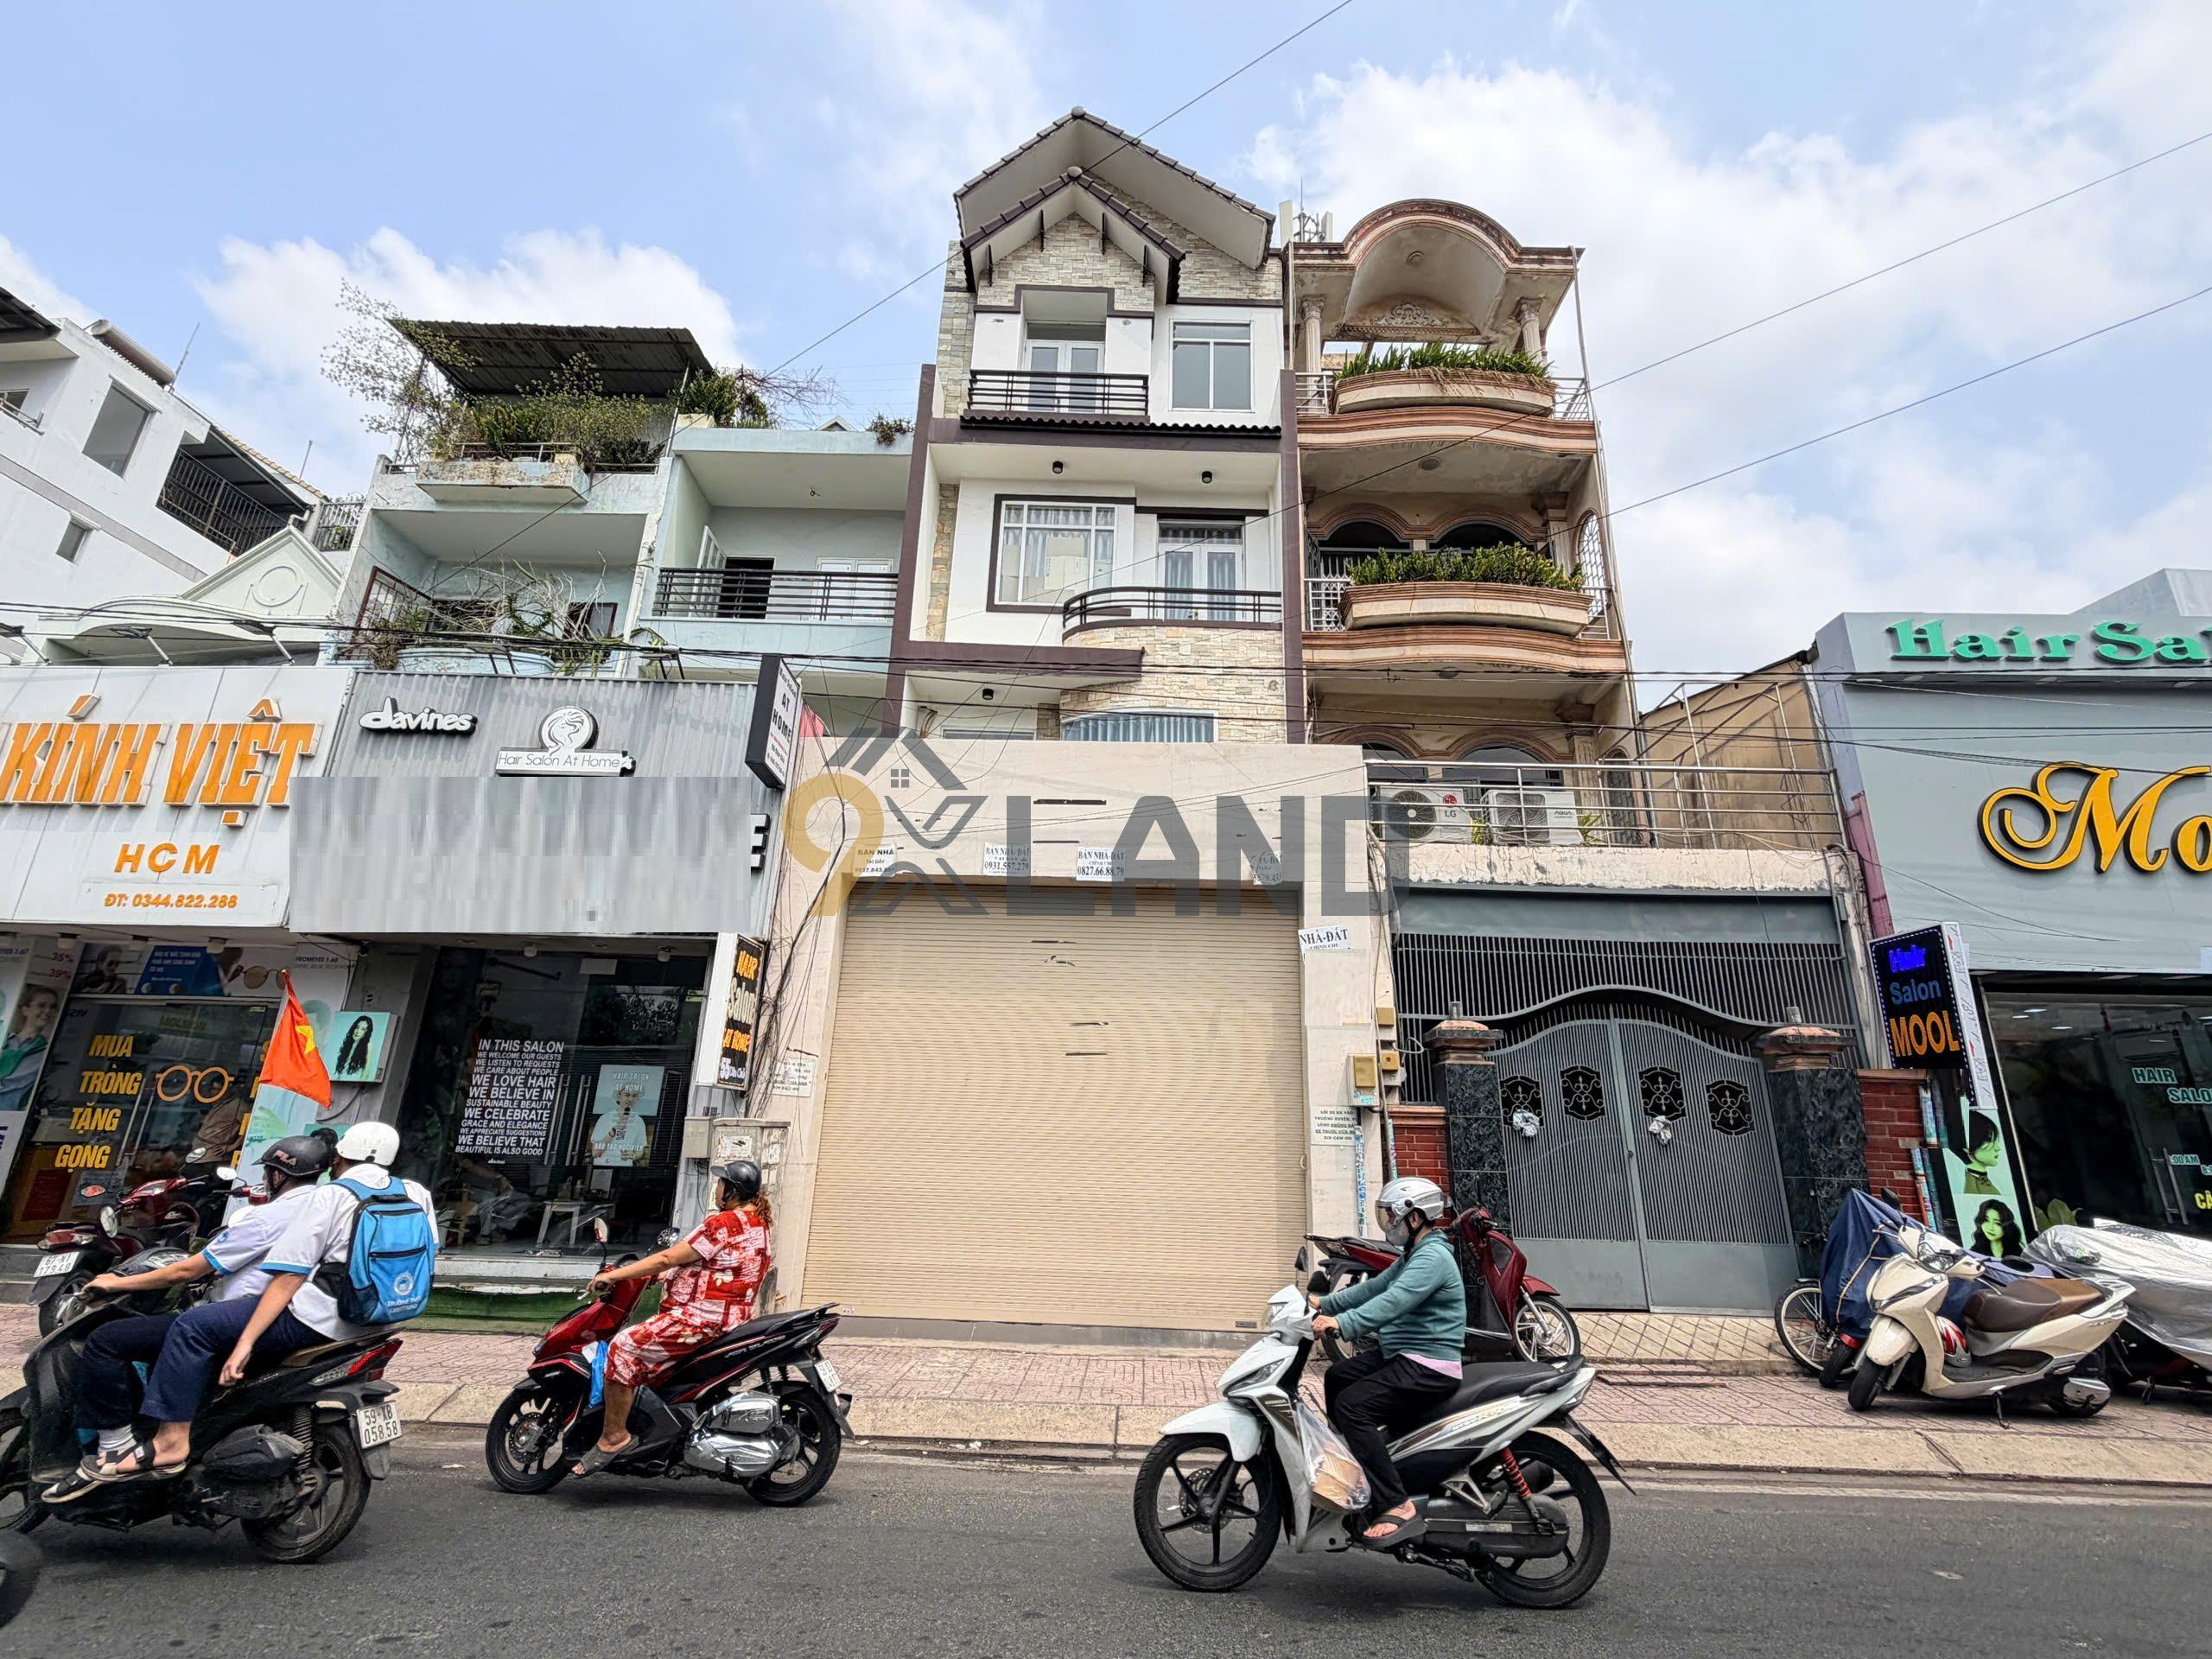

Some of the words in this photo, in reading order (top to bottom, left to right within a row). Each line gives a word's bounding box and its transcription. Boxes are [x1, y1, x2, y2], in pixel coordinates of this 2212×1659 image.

[1886, 618, 2081, 662] Hair
[2093, 620, 2212, 664] Sa
[359, 697, 477, 734] davines
[772, 708, 792, 744] HOME
[0, 693, 166, 804] KÍNH
[162, 698, 320, 827] VIỆT
[498, 753, 523, 766] Hair
[525, 753, 560, 766] Salon
[563, 754, 580, 766] At
[582, 755, 620, 768] Home
[1445, 810, 1457, 818] LG
[104, 893, 127, 907] ĐT:
[131, 893, 238, 908] 0344.822.288
[1300, 927, 1348, 944] NHÀ-ĐẤT
[736, 950, 759, 981] HAIR
[1890, 978, 1942, 1005] Salon
[728, 977, 756, 1025] Salon
[1890, 1010, 1961, 1058] MOOL
[88, 1034, 134, 1058] MUA
[478, 1039, 492, 1051] IN
[494, 1039, 520, 1052] THIS
[523, 1040, 565, 1053] SALON
[488, 1051, 520, 1059] WELCOME
[487, 1058, 512, 1067] LISTEN
[524, 1060, 561, 1069] REQUESTS
[531, 1068, 560, 1077] PEOPLE
[2132, 1067, 2177, 1084] HAIR
[472, 1074, 491, 1086] WE
[493, 1075, 525, 1087] LOVE
[527, 1076, 557, 1089] HAIR
[468, 1086, 488, 1098] WE
[490, 1087, 541, 1100] BELIEVE
[542, 1089, 555, 1101] IN
[466, 1098, 519, 1108] SUSTAINABLE
[520, 1100, 553, 1109] BEAUTY
[69, 1101, 121, 1135] TẶNG
[464, 1107, 483, 1119] WE
[484, 1108, 551, 1122] CELEBRATE
[461, 1119, 488, 1128] GRACE
[488, 1120, 505, 1128] AND
[506, 1121, 549, 1130] ELEGANCE
[458, 1135, 474, 1145] WE
[475, 1135, 518, 1147] BELIEVE
[519, 1136, 545, 1147] THAT
[454, 1145, 493, 1154] BEAUTIFUL
[501, 1147, 521, 1155] ALSO
[522, 1147, 543, 1156] GOOD
[54, 1144, 111, 1173] GỌNG
